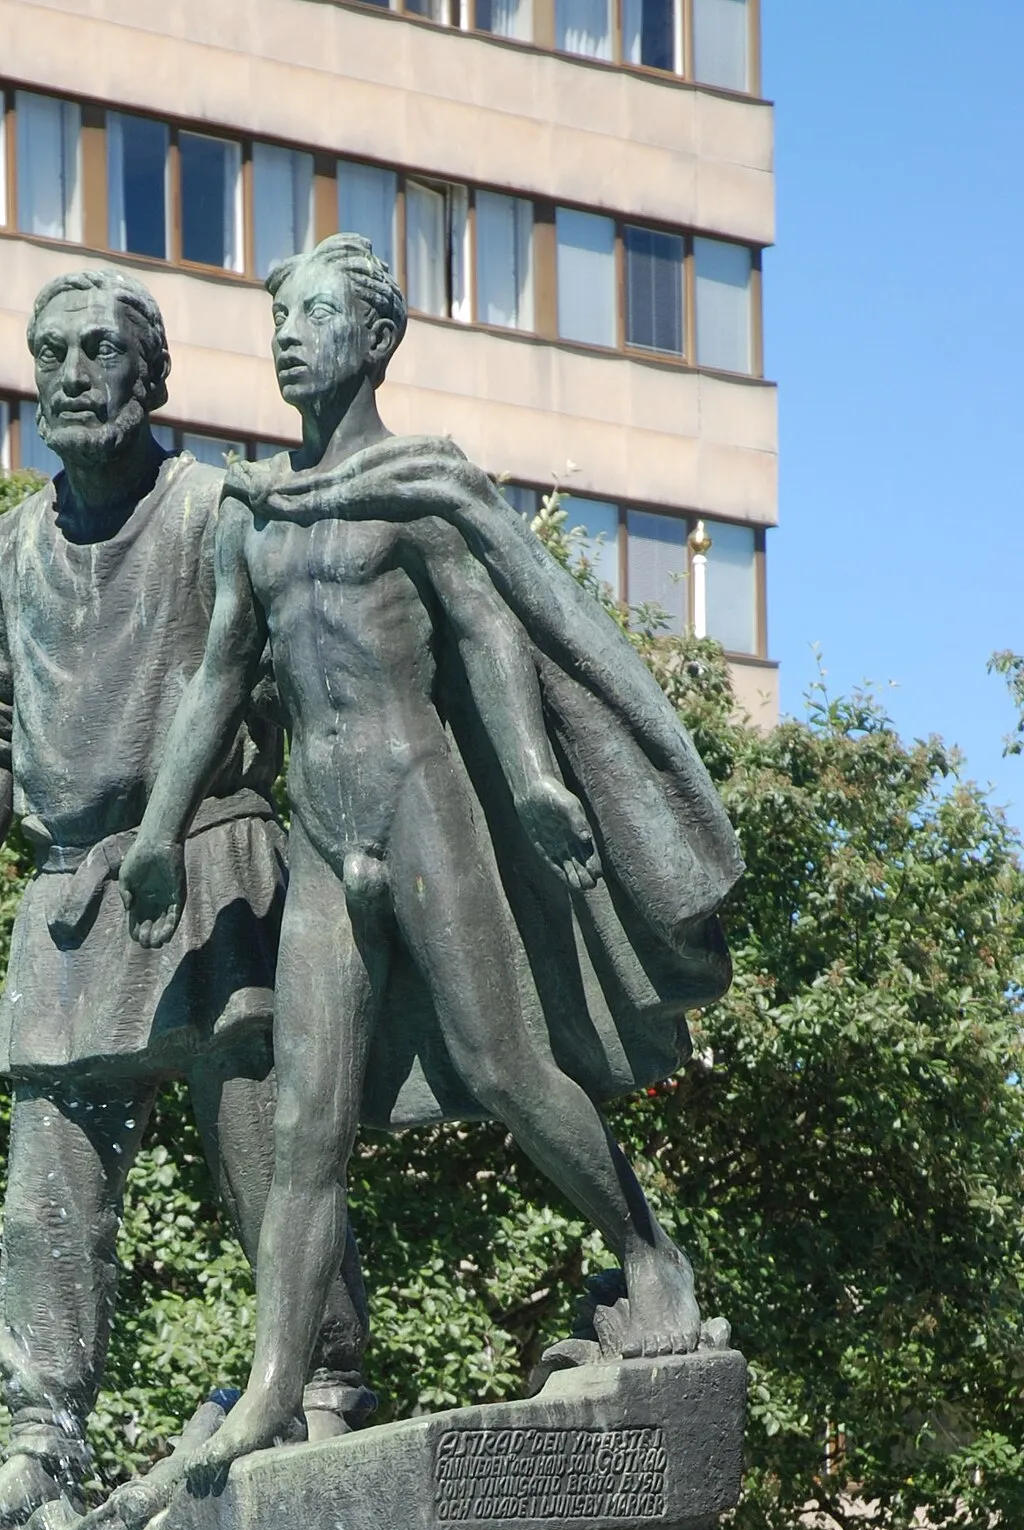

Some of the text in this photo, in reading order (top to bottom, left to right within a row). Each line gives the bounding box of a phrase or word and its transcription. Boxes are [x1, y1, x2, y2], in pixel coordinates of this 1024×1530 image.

[436, 1430, 524, 1459] ASTRAD
[571, 1430, 651, 1454] YPPERSTE
[652, 1428, 663, 1449] I
[510, 1456, 536, 1477] OCH
[535, 1453, 567, 1477] HANS
[567, 1453, 595, 1475] SON
[435, 1477, 467, 1501] SOM
[479, 1474, 561, 1498] VIKINGATID
[619, 1471, 664, 1493] BYGD
[437, 1497, 472, 1520] OCH
[473, 1496, 528, 1519] ODLADE
[539, 1493, 604, 1518] LJUNGBY
[603, 1491, 665, 1517] MARKER
